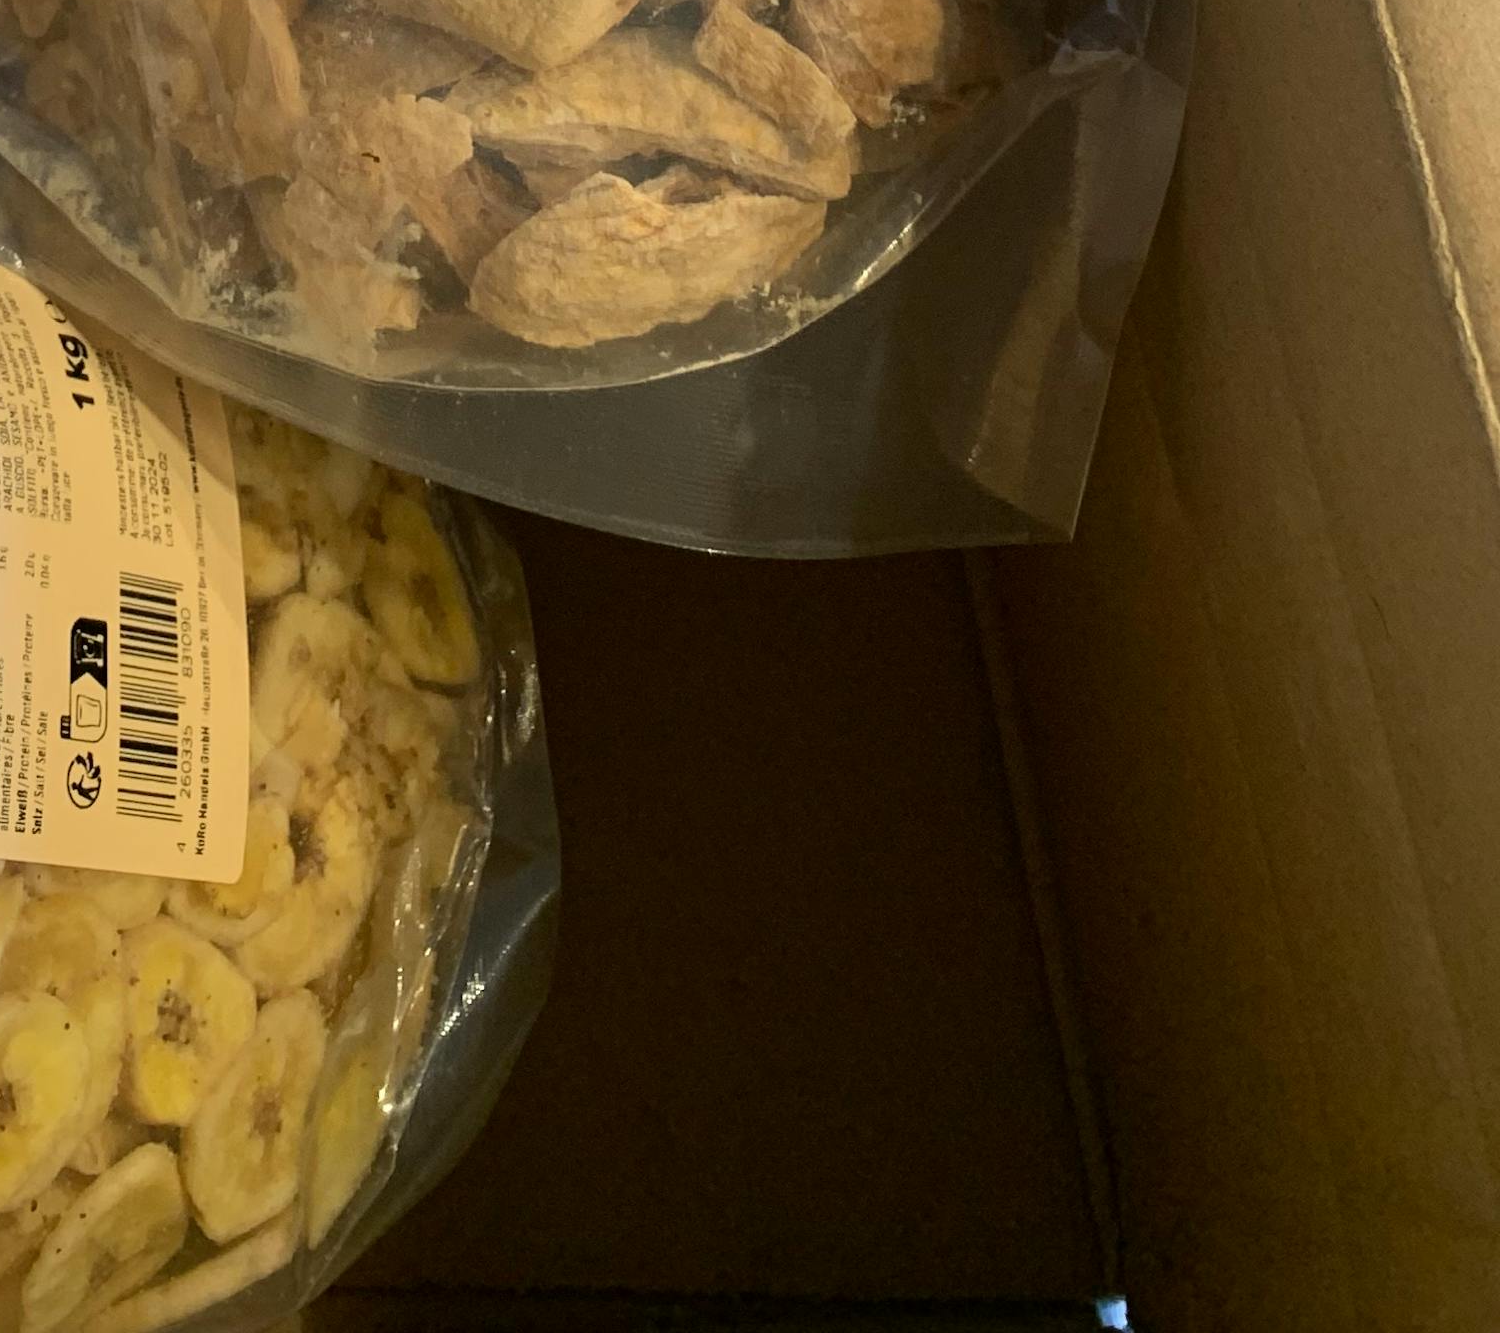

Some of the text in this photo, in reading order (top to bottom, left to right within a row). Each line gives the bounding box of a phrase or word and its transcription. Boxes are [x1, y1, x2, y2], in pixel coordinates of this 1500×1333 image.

[58, 333, 95, 410] 1 kg
[180, 607, 193, 799] 260335 831090
